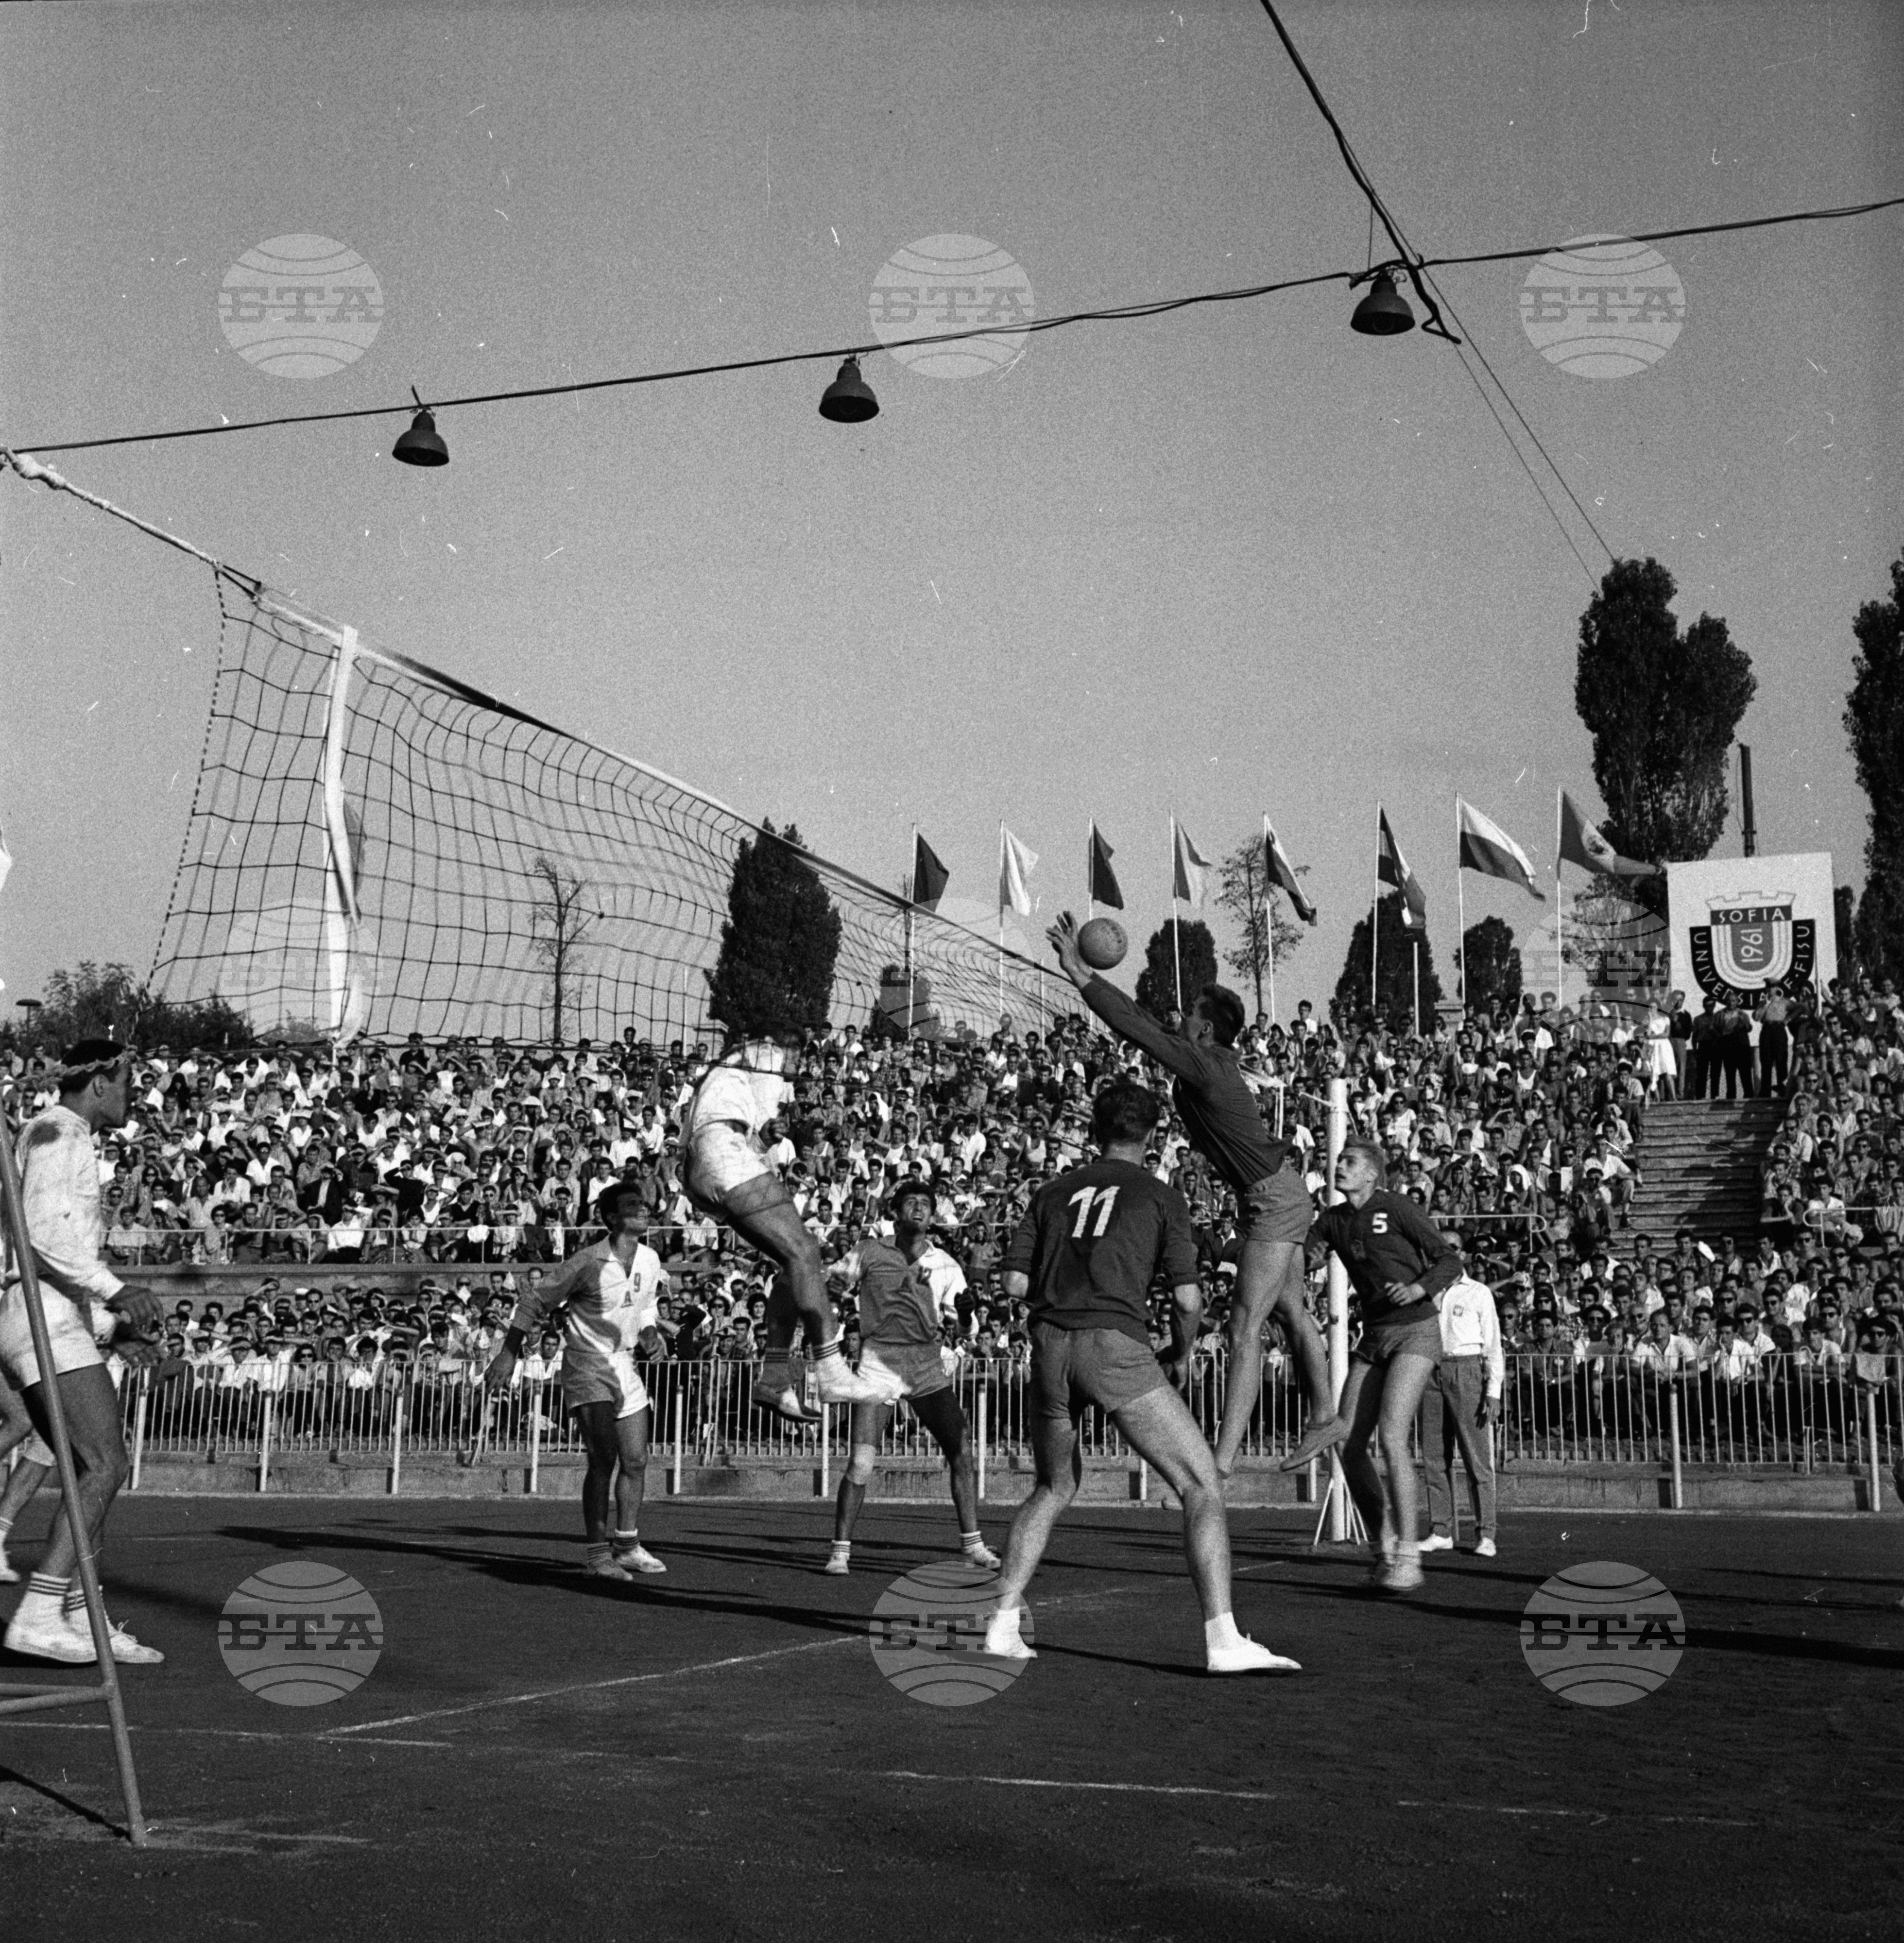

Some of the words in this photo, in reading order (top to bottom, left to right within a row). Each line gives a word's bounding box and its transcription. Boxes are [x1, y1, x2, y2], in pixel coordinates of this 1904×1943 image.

[1719, 907, 1786, 924] SOFIA
[1740, 928, 1764, 963] 1961
[1067, 1185, 1121, 1238] 11
[1372, 1212, 1388, 1234] 5
[634, 1272, 641, 1293] 9
[916, 1265, 932, 1286] 12
